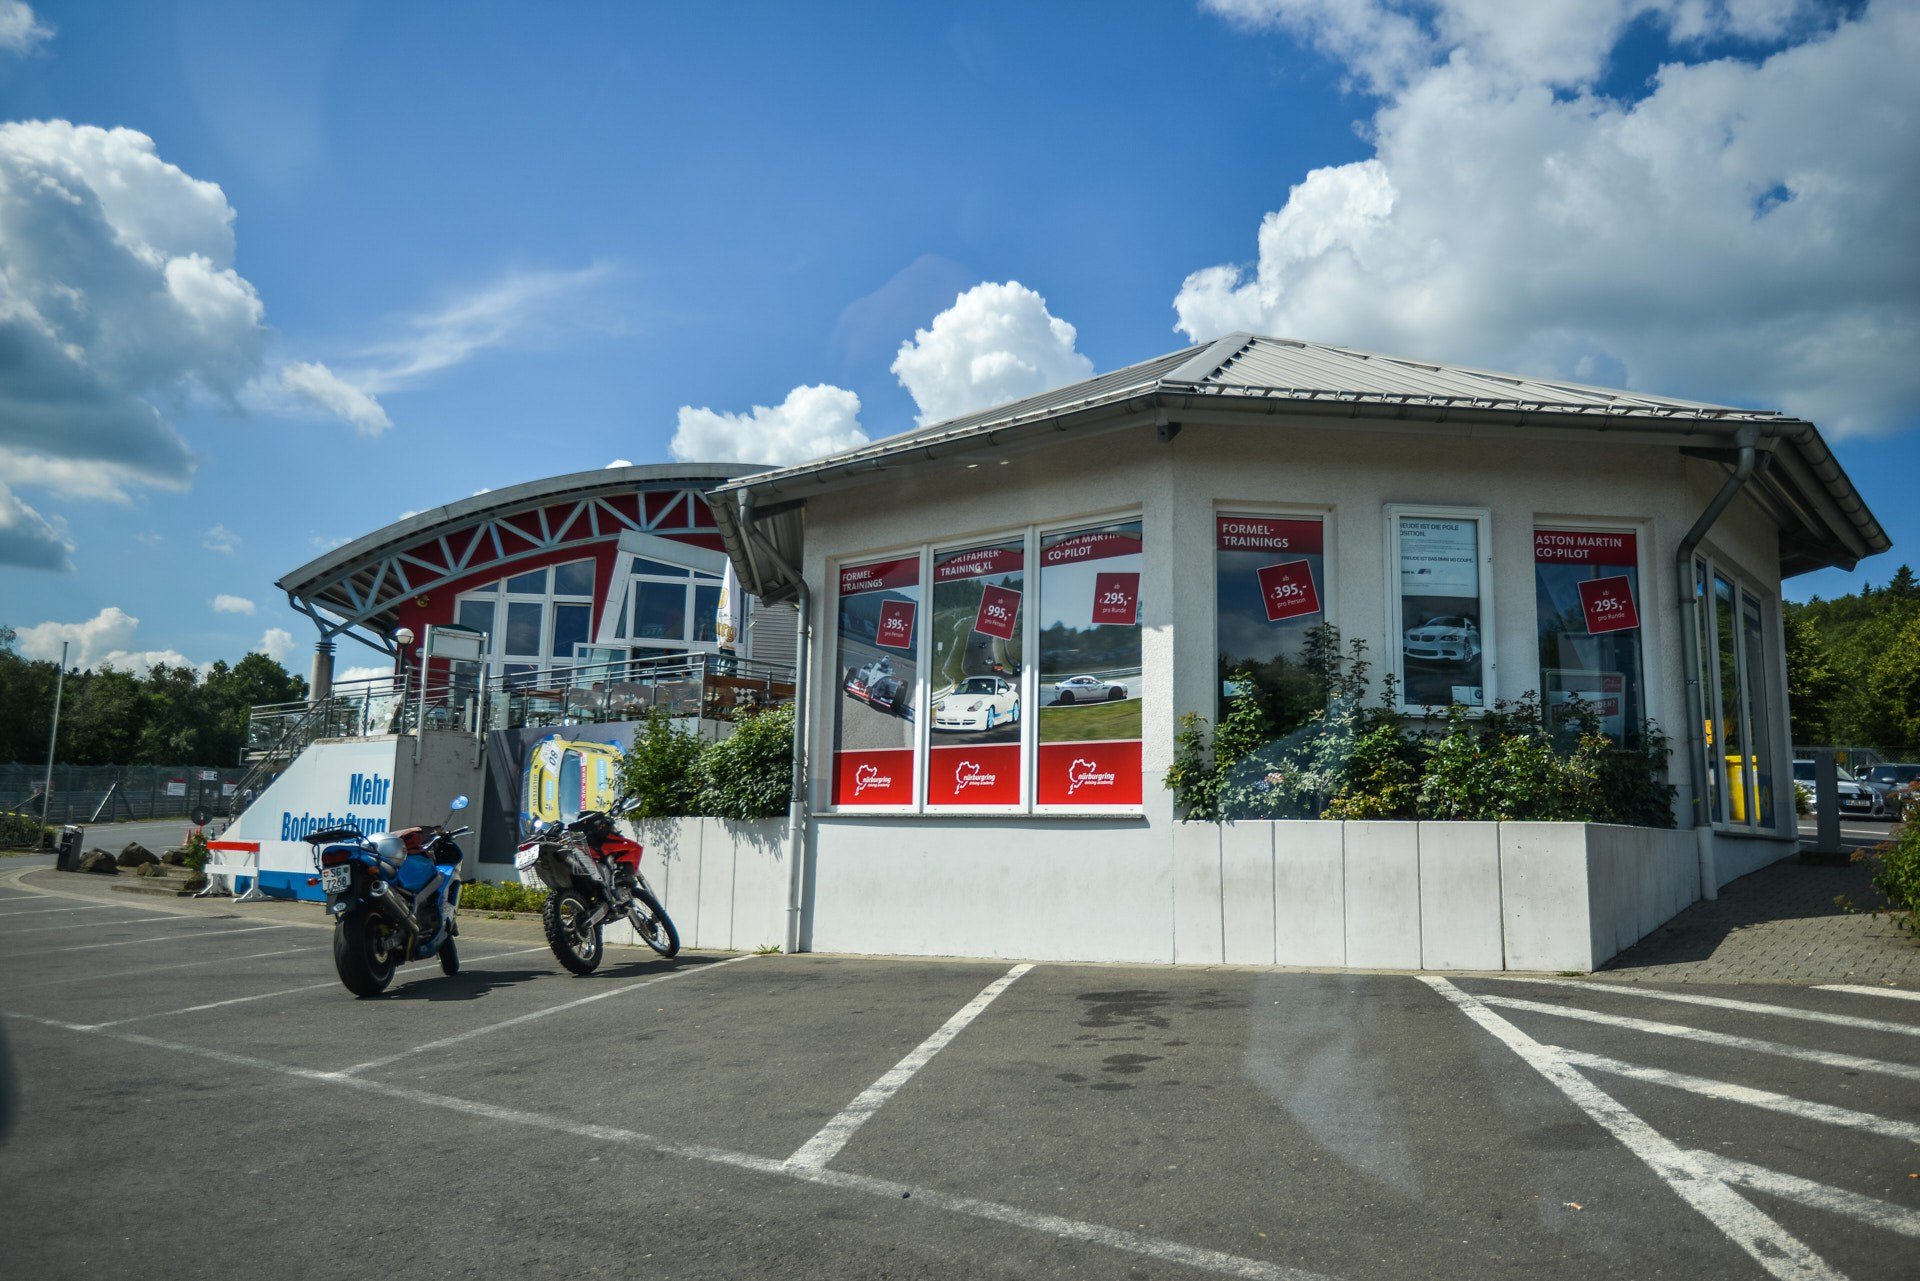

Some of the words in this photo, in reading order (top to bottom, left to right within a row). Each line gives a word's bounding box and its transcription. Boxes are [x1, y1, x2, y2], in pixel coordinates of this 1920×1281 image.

[1222, 523, 1275, 535] FORMEL-
[1223, 536, 1289, 548] TRAININGS
[1536, 535, 1574, 546] ASTON
[1577, 537, 1622, 548] MARTIN
[1048, 546, 1092, 560] CO-PILOT
[1536, 548, 1589, 559] CO-PILOT
[940, 563, 981, 576] TRAINING
[983, 561, 993, 570] XL
[842, 570, 875, 582] FORMEL-
[842, 578, 883, 592] TRAININGS
[1277, 601, 1287, 609] pro
[1287, 597, 1306, 607] Person
[1608, 612, 1625, 620] Runde
[863, 776, 891, 784] nürburgring
[963, 773, 996, 782] nürburgring
[1078, 772, 1115, 781] nürburgring
[348, 773, 391, 805] Mehr
[331, 867, 342, 878] SG
